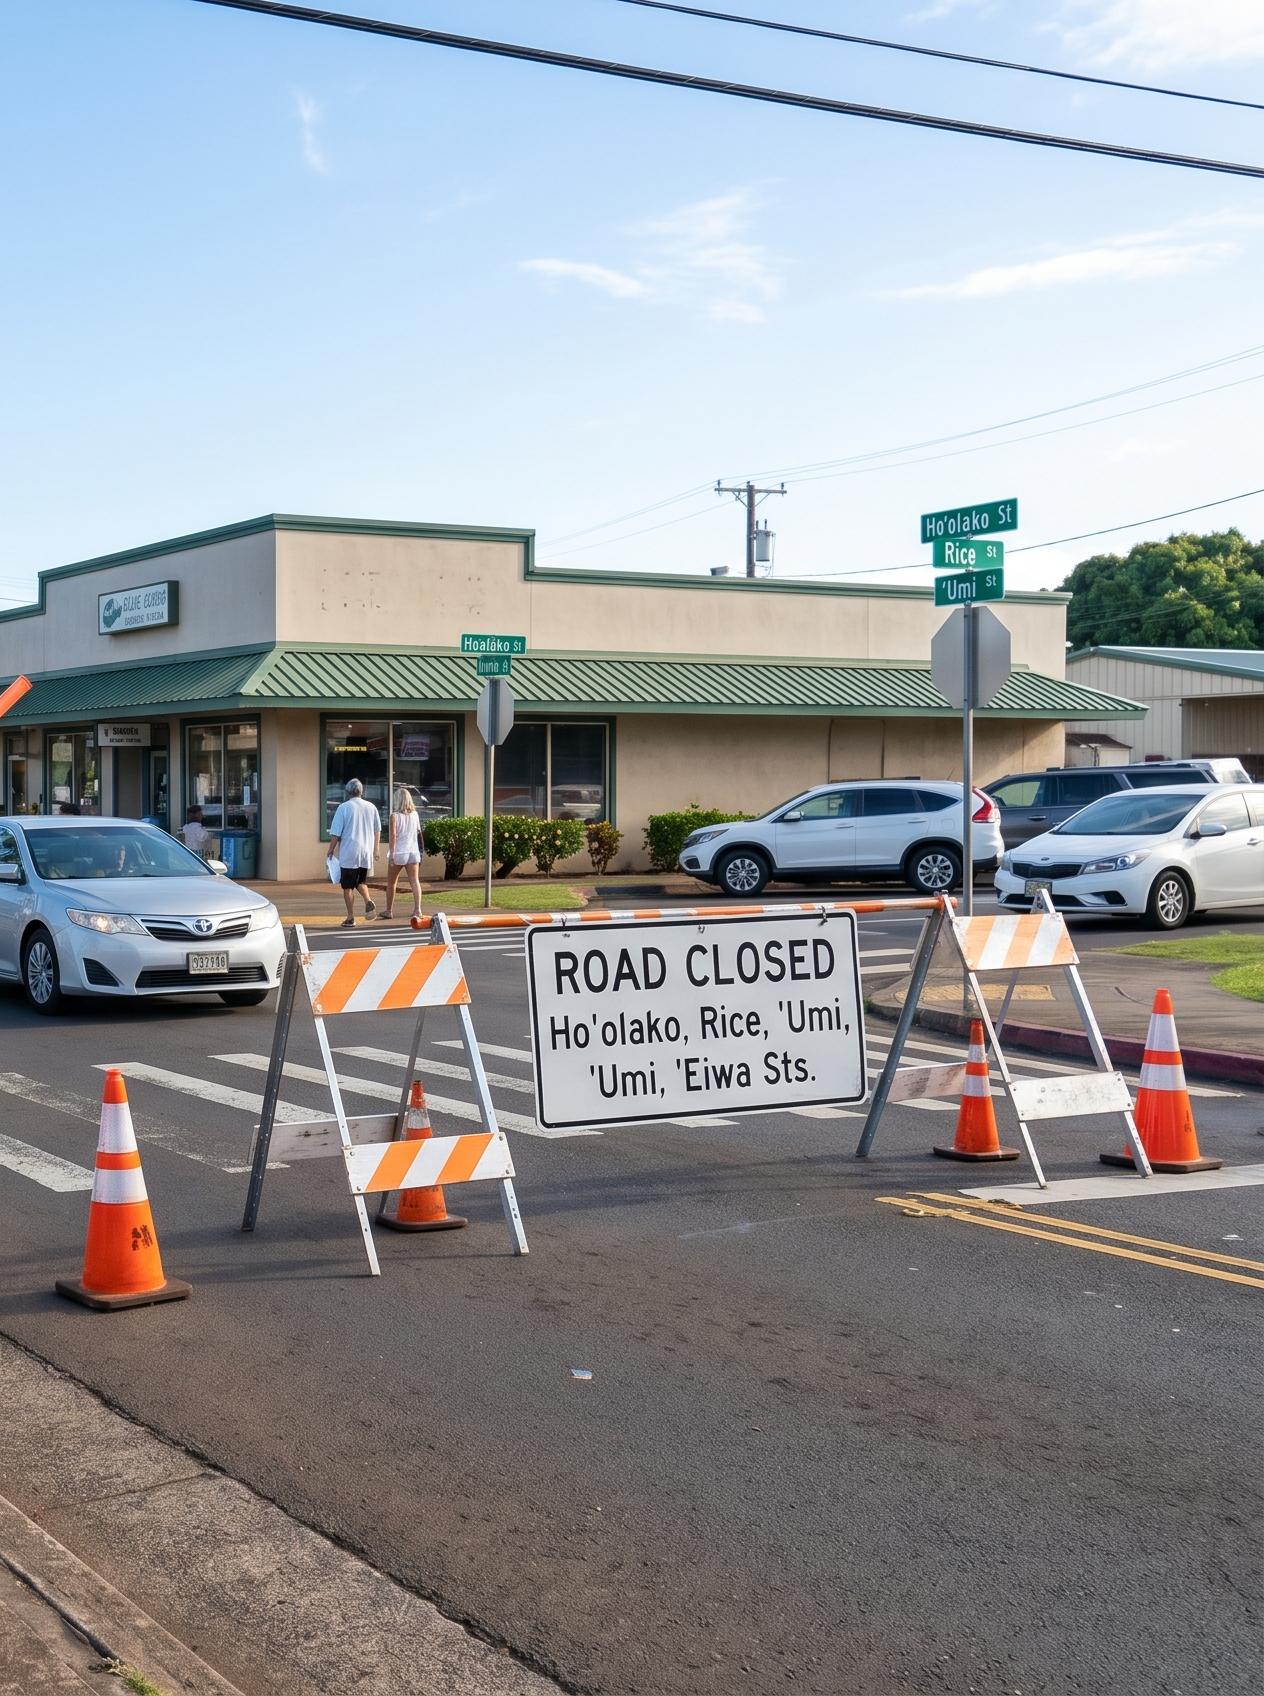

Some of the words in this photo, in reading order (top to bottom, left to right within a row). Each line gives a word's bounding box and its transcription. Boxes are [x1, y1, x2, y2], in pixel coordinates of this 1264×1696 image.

[926, 510, 989, 538] Ho'olako
[998, 504, 1013, 525] St
[944, 541, 977, 565] Rice
[986, 545, 997, 558] St
[985, 574, 997, 587] St
[554, 947, 667, 995] ROAD
[686, 938, 835, 987] CLOSED
[549, 1010, 689, 1050] Ho'olako,
[700, 1005, 769, 1041] Rice,
[778, 997, 850, 1036] 'Umi,
[589, 1061, 665, 1099] 'Umi,
[675, 1056, 752, 1092] 'Eiwa
[763, 1051, 817, 1086] Sts.
